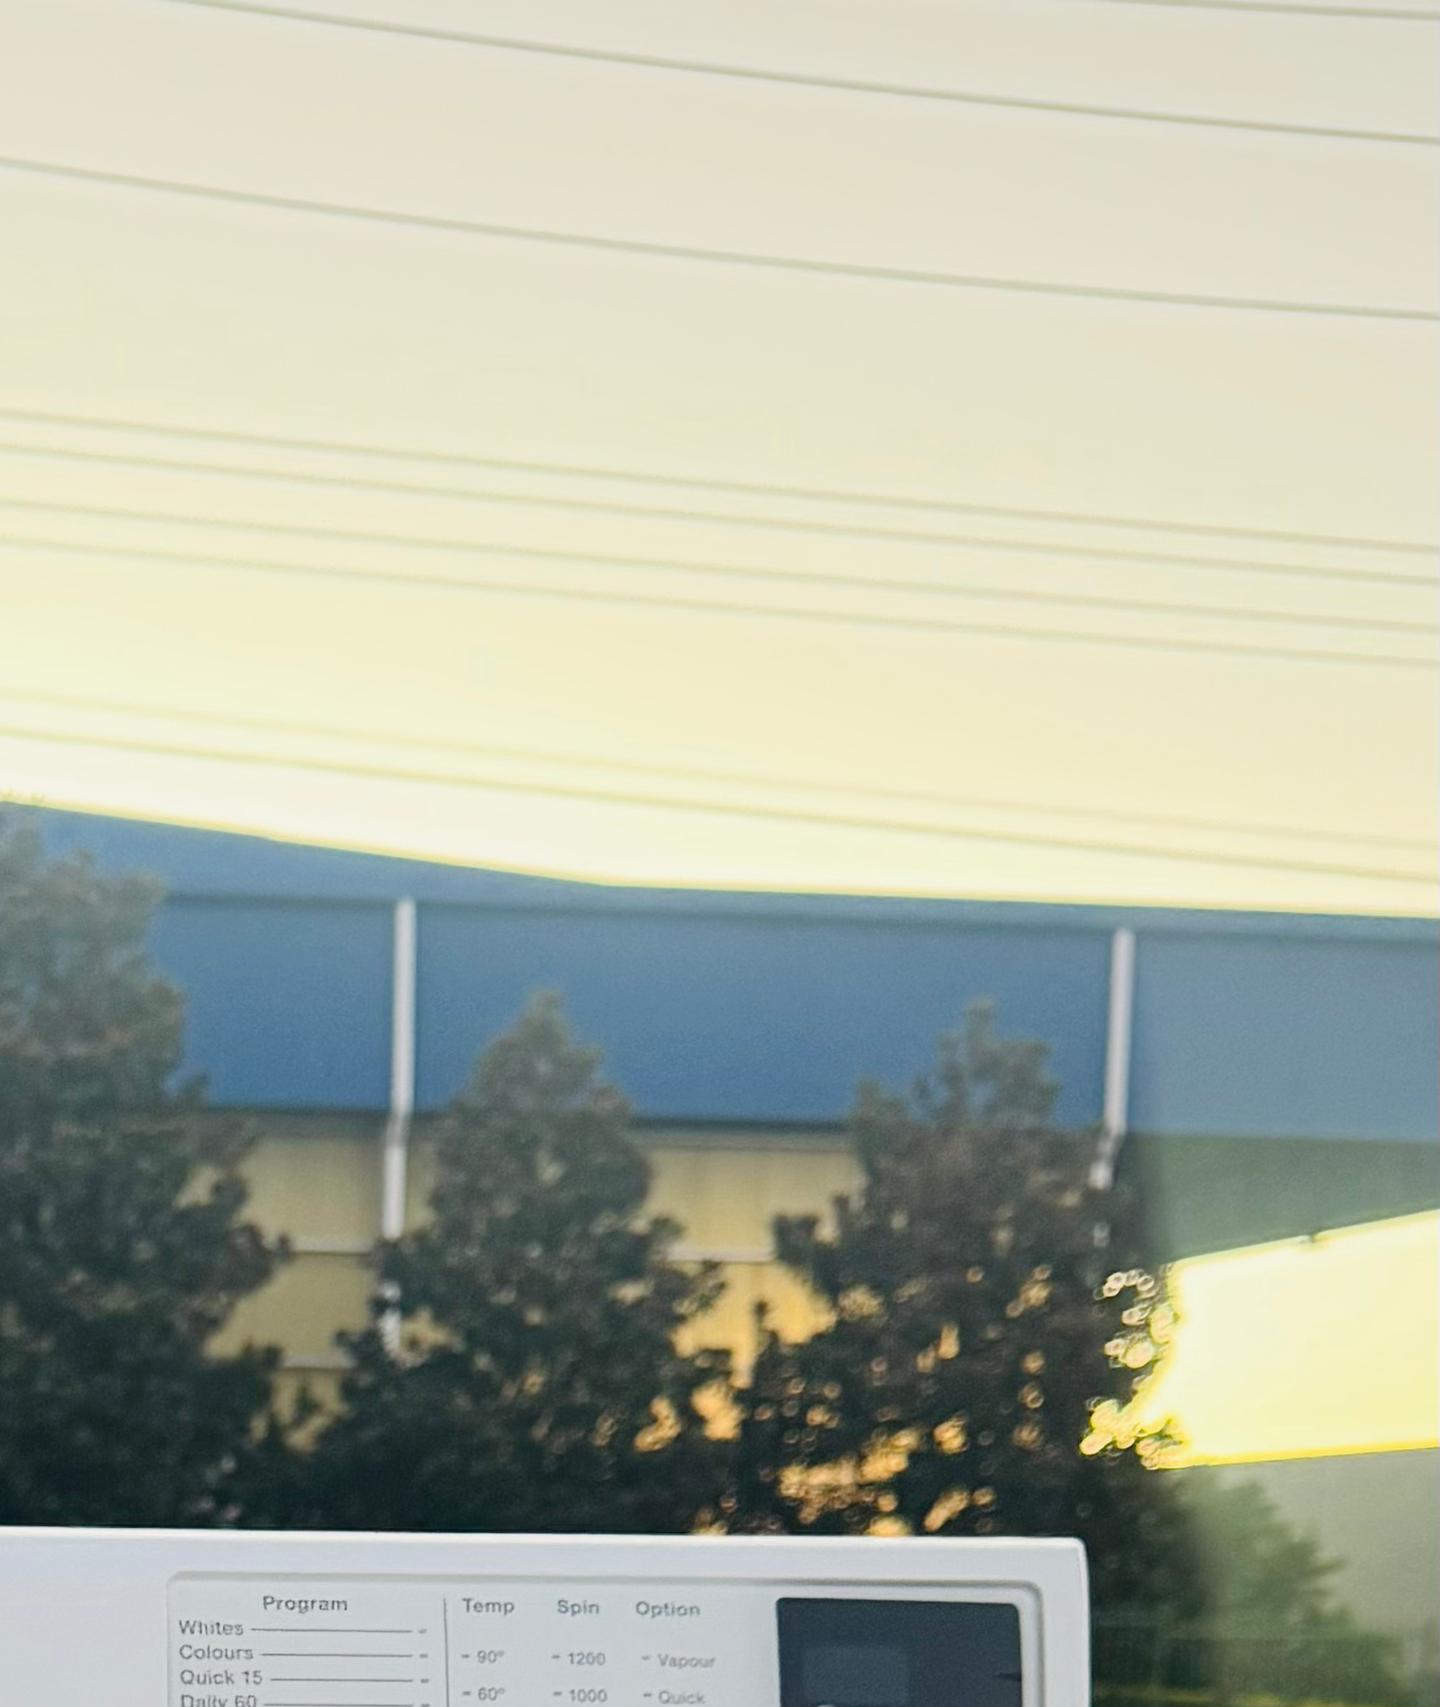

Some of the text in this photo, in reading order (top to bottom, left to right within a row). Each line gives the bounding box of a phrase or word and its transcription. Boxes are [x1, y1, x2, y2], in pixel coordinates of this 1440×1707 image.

[263, 1596, 348, 1614] Program
[462, 1598, 514, 1615] Temp
[557, 1600, 600, 1616] Spin
[635, 1601, 700, 1618] Option
[179, 1620, 244, 1636] Whites
[179, 1645, 254, 1660] Colours
[477, 1651, 505, 1665] 90°
[569, 1652, 606, 1666] 1200
[658, 1654, 715, 1670] Vapour
[180, 1670, 262, 1686] Quick 15
[478, 1687, 505, 1701] 60°
[569, 1689, 607, 1703] 1000
[659, 1691, 705, 1705] Quick
